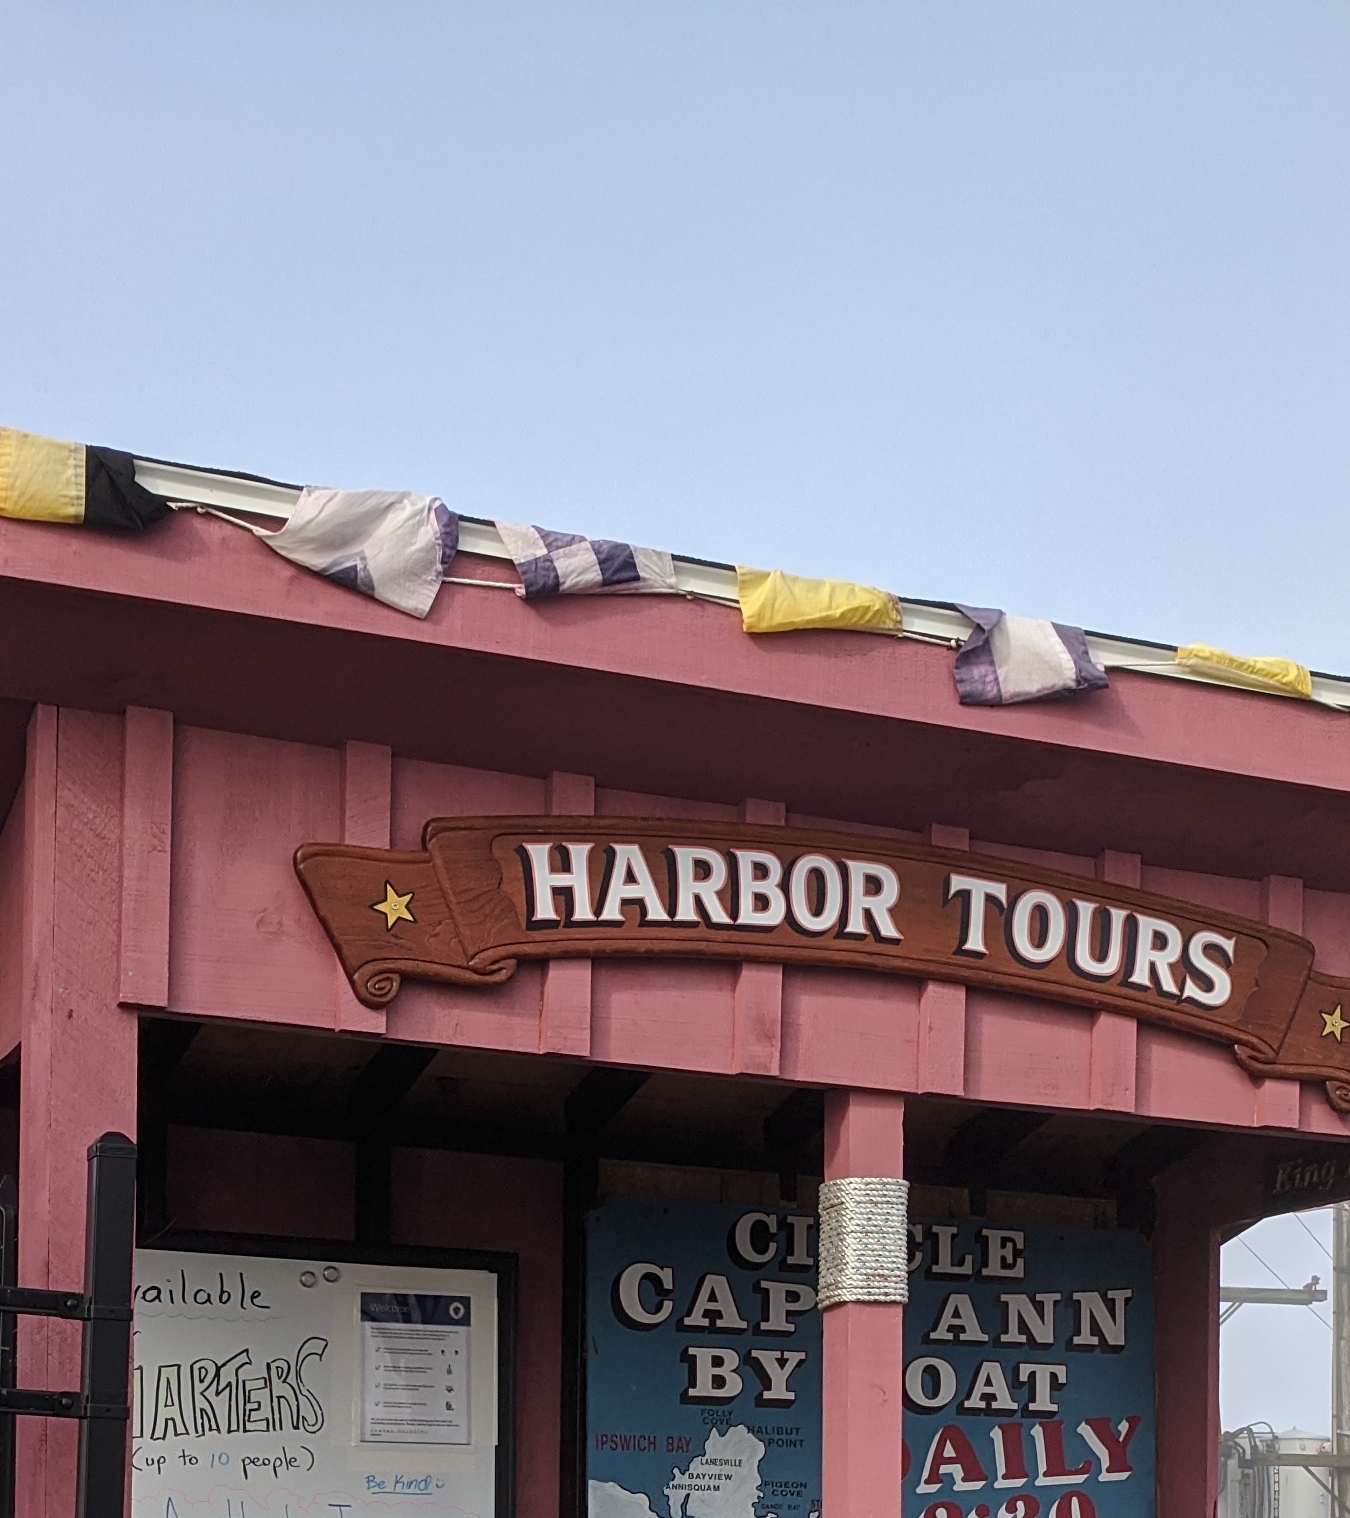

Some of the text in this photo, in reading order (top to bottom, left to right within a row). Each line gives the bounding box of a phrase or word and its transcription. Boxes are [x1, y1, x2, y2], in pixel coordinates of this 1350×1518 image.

[519, 841, 1238, 1009] HARBOR TOURS
[1272, 1158, 1337, 1195] King
[733, 1212, 1025, 1278] CILE
[135, 1269, 271, 1309] ailable
[618, 1262, 1133, 1346] CAP ANN
[687, 1346, 1068, 1412] BY OAT
[133, 1337, 328, 1441] ARTERS
[700, 1409, 733, 1418] FOLLY
[702, 1417, 732, 1426] COVE
[748, 1426, 802, 1437] HALIBUT
[595, 1434, 693, 1453] IPSWICH BAY
[767, 1438, 805, 1449] POINT
[901, 1416, 1142, 1491] AILY
[178, 1449, 199, 1466] to
[211, 1452, 230, 1468] 10
[241, 1446, 315, 1480] people)
[700, 1458, 743, 1467] LANESVILLE
[365, 1475, 432, 1490] Be Kind
[688, 1473, 733, 1481] BAYVIEW
[764, 1481, 808, 1489] PIGEON
[665, 1483, 721, 1492] ANNISQUAM
[771, 1489, 803, 1498] COVE
